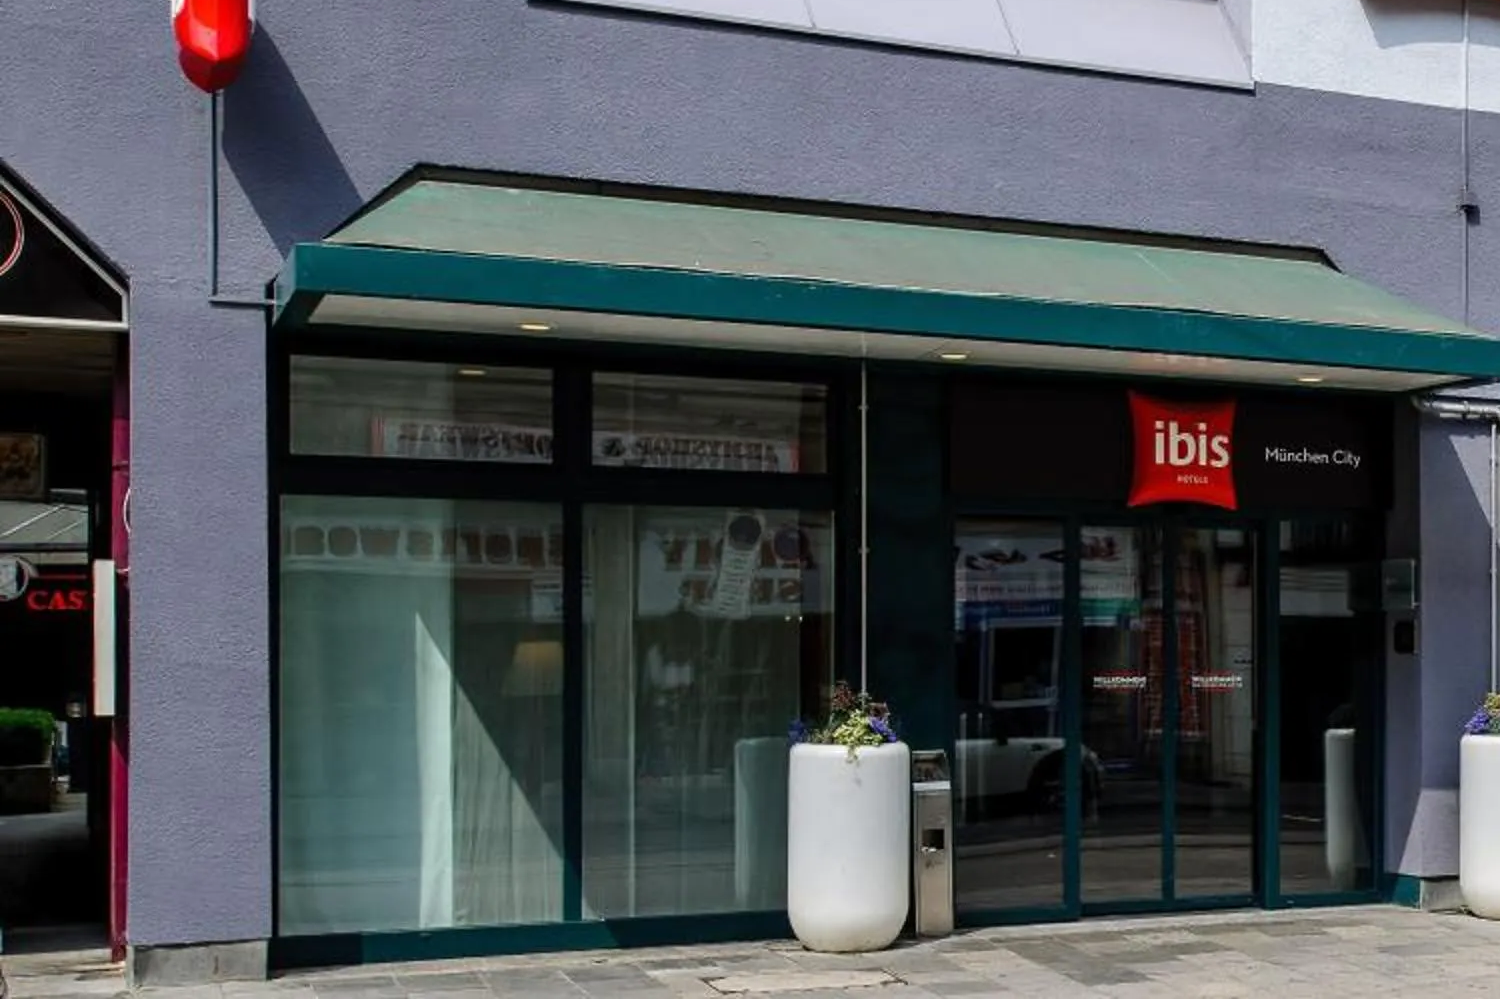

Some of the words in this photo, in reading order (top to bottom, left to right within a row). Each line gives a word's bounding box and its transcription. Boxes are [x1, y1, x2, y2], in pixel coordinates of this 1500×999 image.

[1154, 420, 1230, 468] ibis
[1264, 447, 1329, 464] München
[1332, 450, 1362, 468] City
[27, 590, 88, 611] CAS
